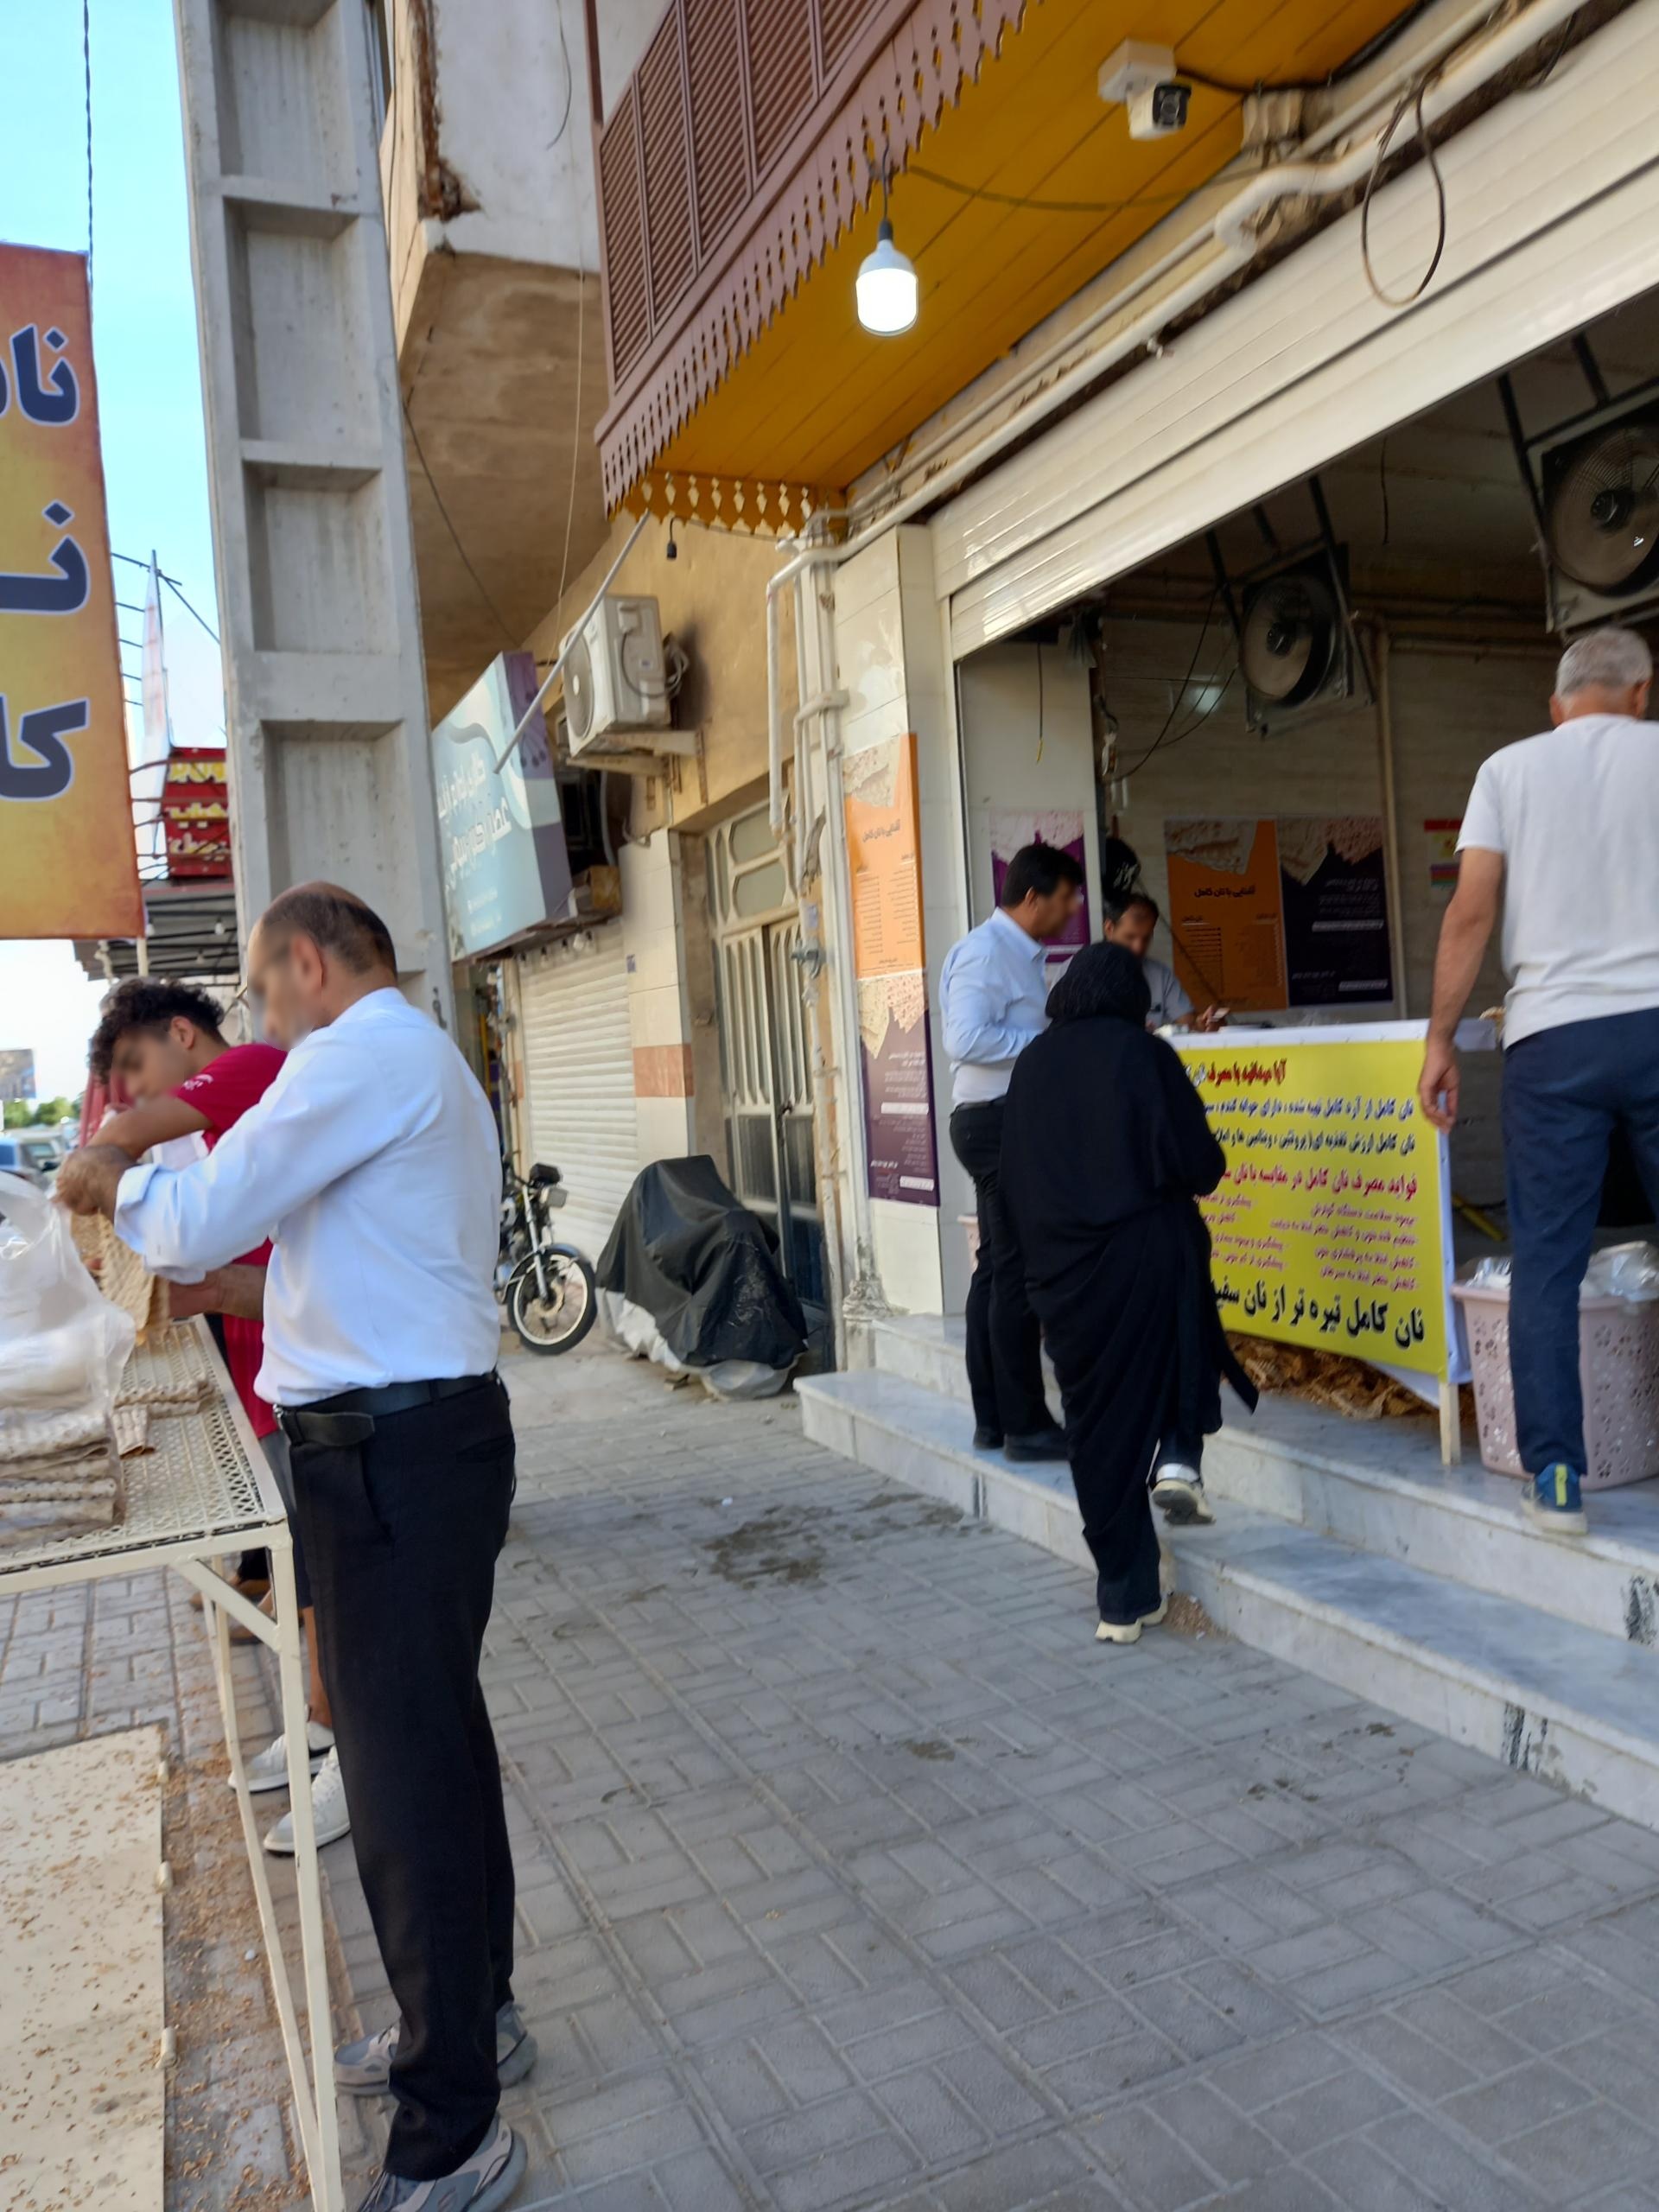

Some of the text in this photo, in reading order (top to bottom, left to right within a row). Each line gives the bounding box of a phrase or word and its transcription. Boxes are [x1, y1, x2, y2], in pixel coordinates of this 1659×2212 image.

[0, 323, 79, 428] نا
[1324, 1097, 1344, 1119] کامل
[1375, 1097, 1396, 1119] کامل
[1399, 1098, 1414, 1121] نان
[1376, 1133, 1397, 1154] کامل
[1400, 1133, 1415, 1156] نان
[1306, 1167, 1328, 1192] کامل
[1332, 1167, 1348, 1195] نان
[1351, 1168, 1384, 1198] مصرف
[1388, 1173, 1417, 1202] فواید
[1244, 1279, 1268, 1317] نان
[1271, 1283, 1287, 1323] از
[1289, 1287, 1306, 1327] تر
[1309, 1294, 1344, 1334] تیره
[1346, 1297, 1389, 1337] کامل
[1395, 1306, 1425, 1349] نان
